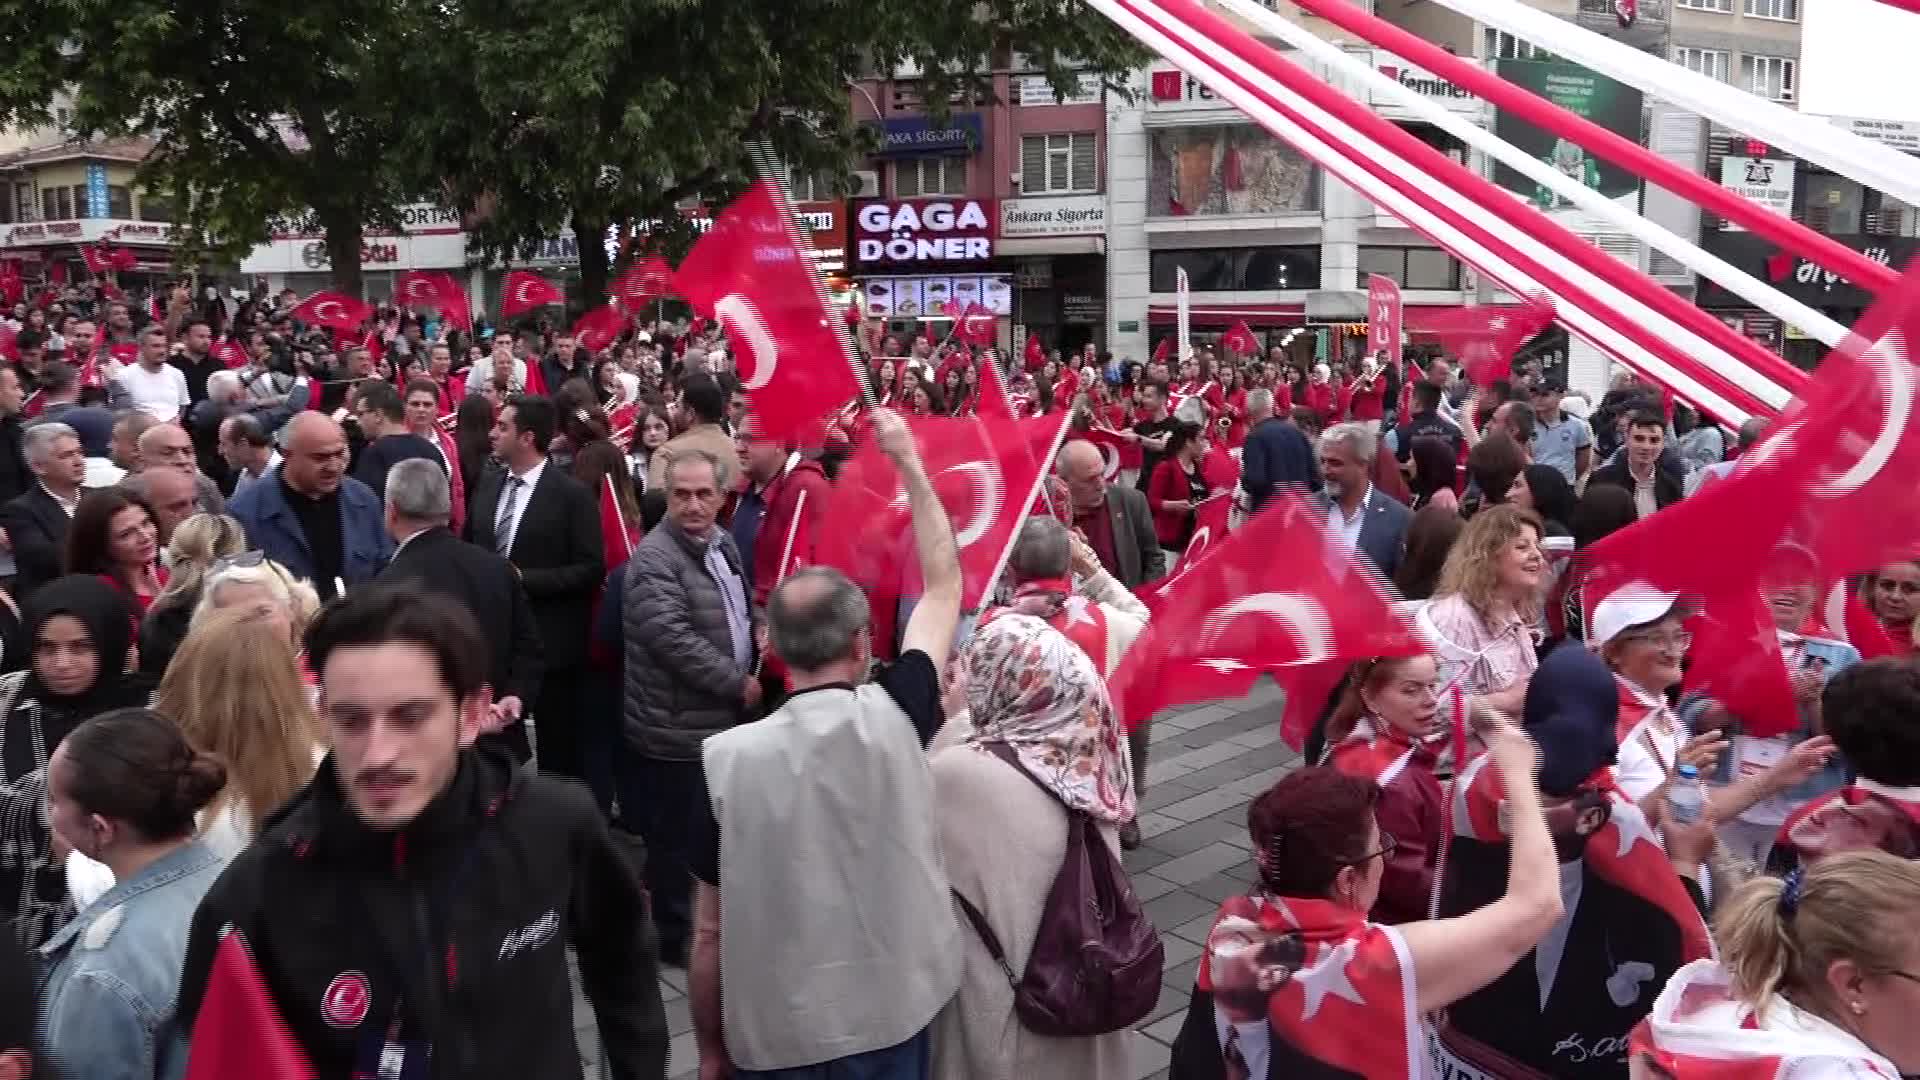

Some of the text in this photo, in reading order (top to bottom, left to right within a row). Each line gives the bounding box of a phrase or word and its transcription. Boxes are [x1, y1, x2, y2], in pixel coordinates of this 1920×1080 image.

[858, 202, 988, 232] GAGA
[1005, 211, 1052, 224] Ankara
[360, 244, 398, 263] SCH
[858, 231, 990, 261] DÖNER
